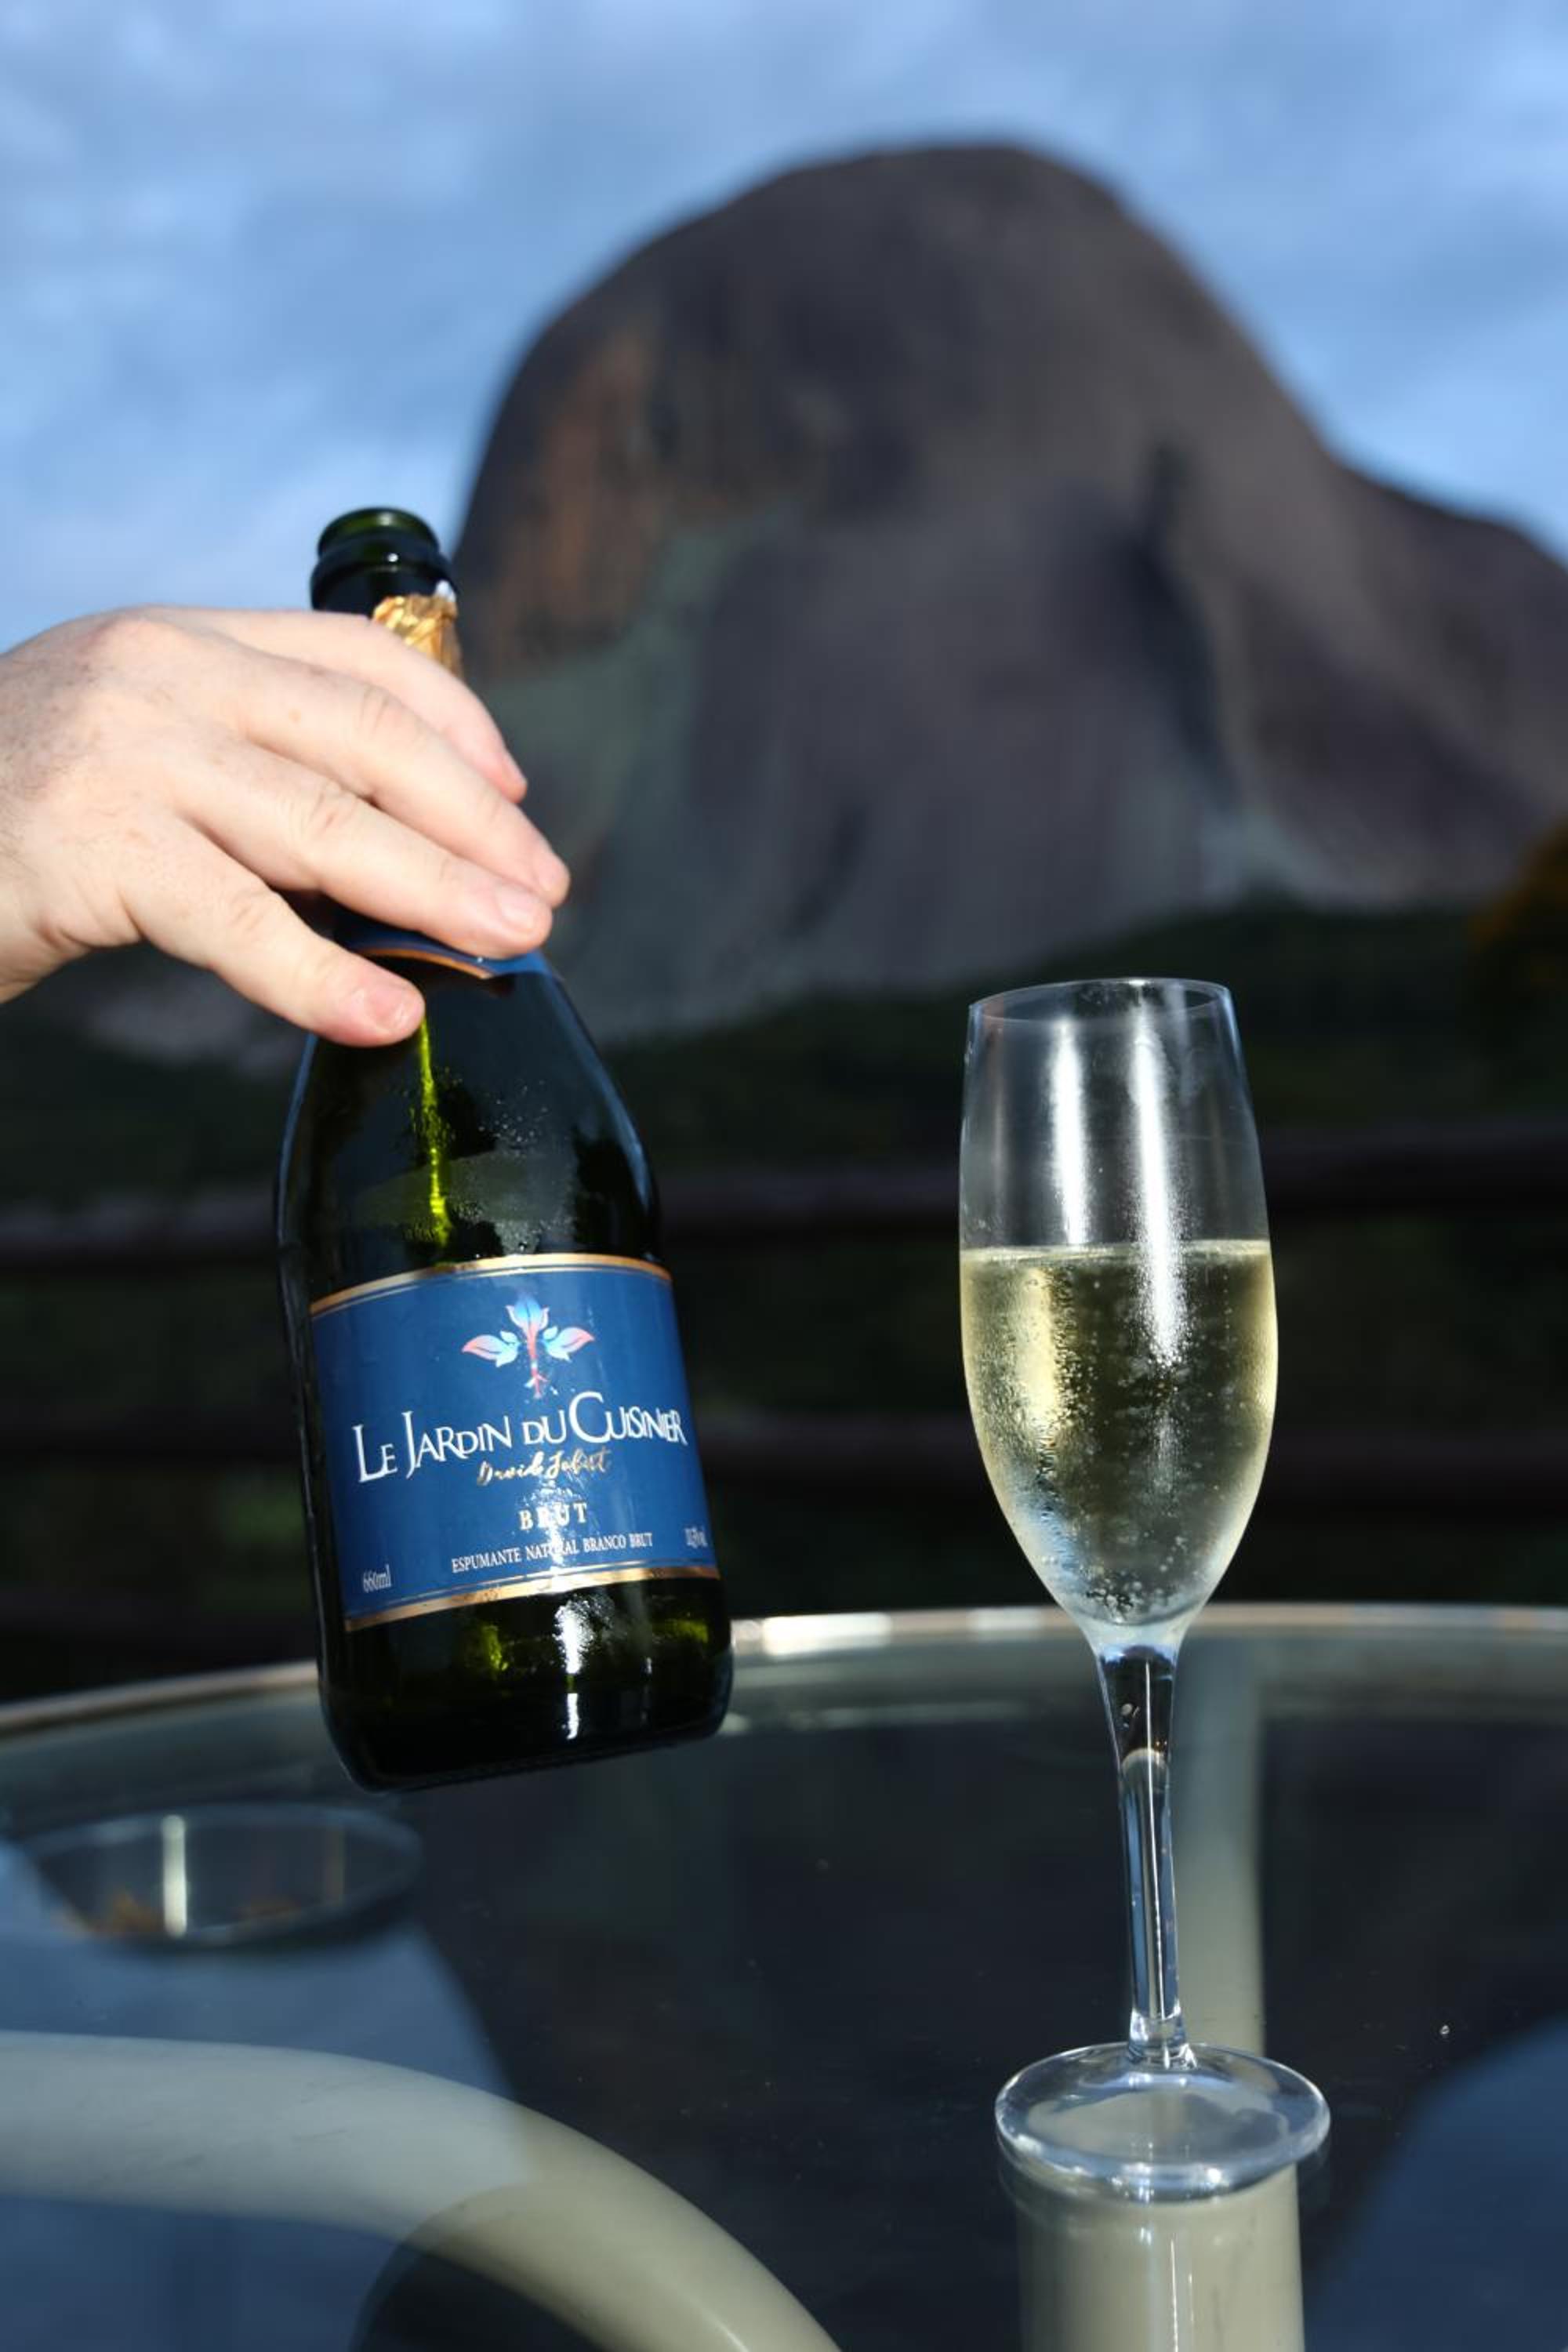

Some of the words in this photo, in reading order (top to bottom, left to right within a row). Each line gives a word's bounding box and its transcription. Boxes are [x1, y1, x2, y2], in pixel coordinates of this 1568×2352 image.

[352, 1424, 398, 1483] LE
[401, 1410, 513, 1479] JARDIN
[521, 1410, 568, 1446] DU
[568, 1391, 689, 1446] CUISINIER
[518, 1501, 588, 1530] BRUT
[452, 1548, 521, 1573] ESPUMANTE
[583, 1534, 626, 1554] BRANCO
[630, 1532, 653, 1548] BRUT
